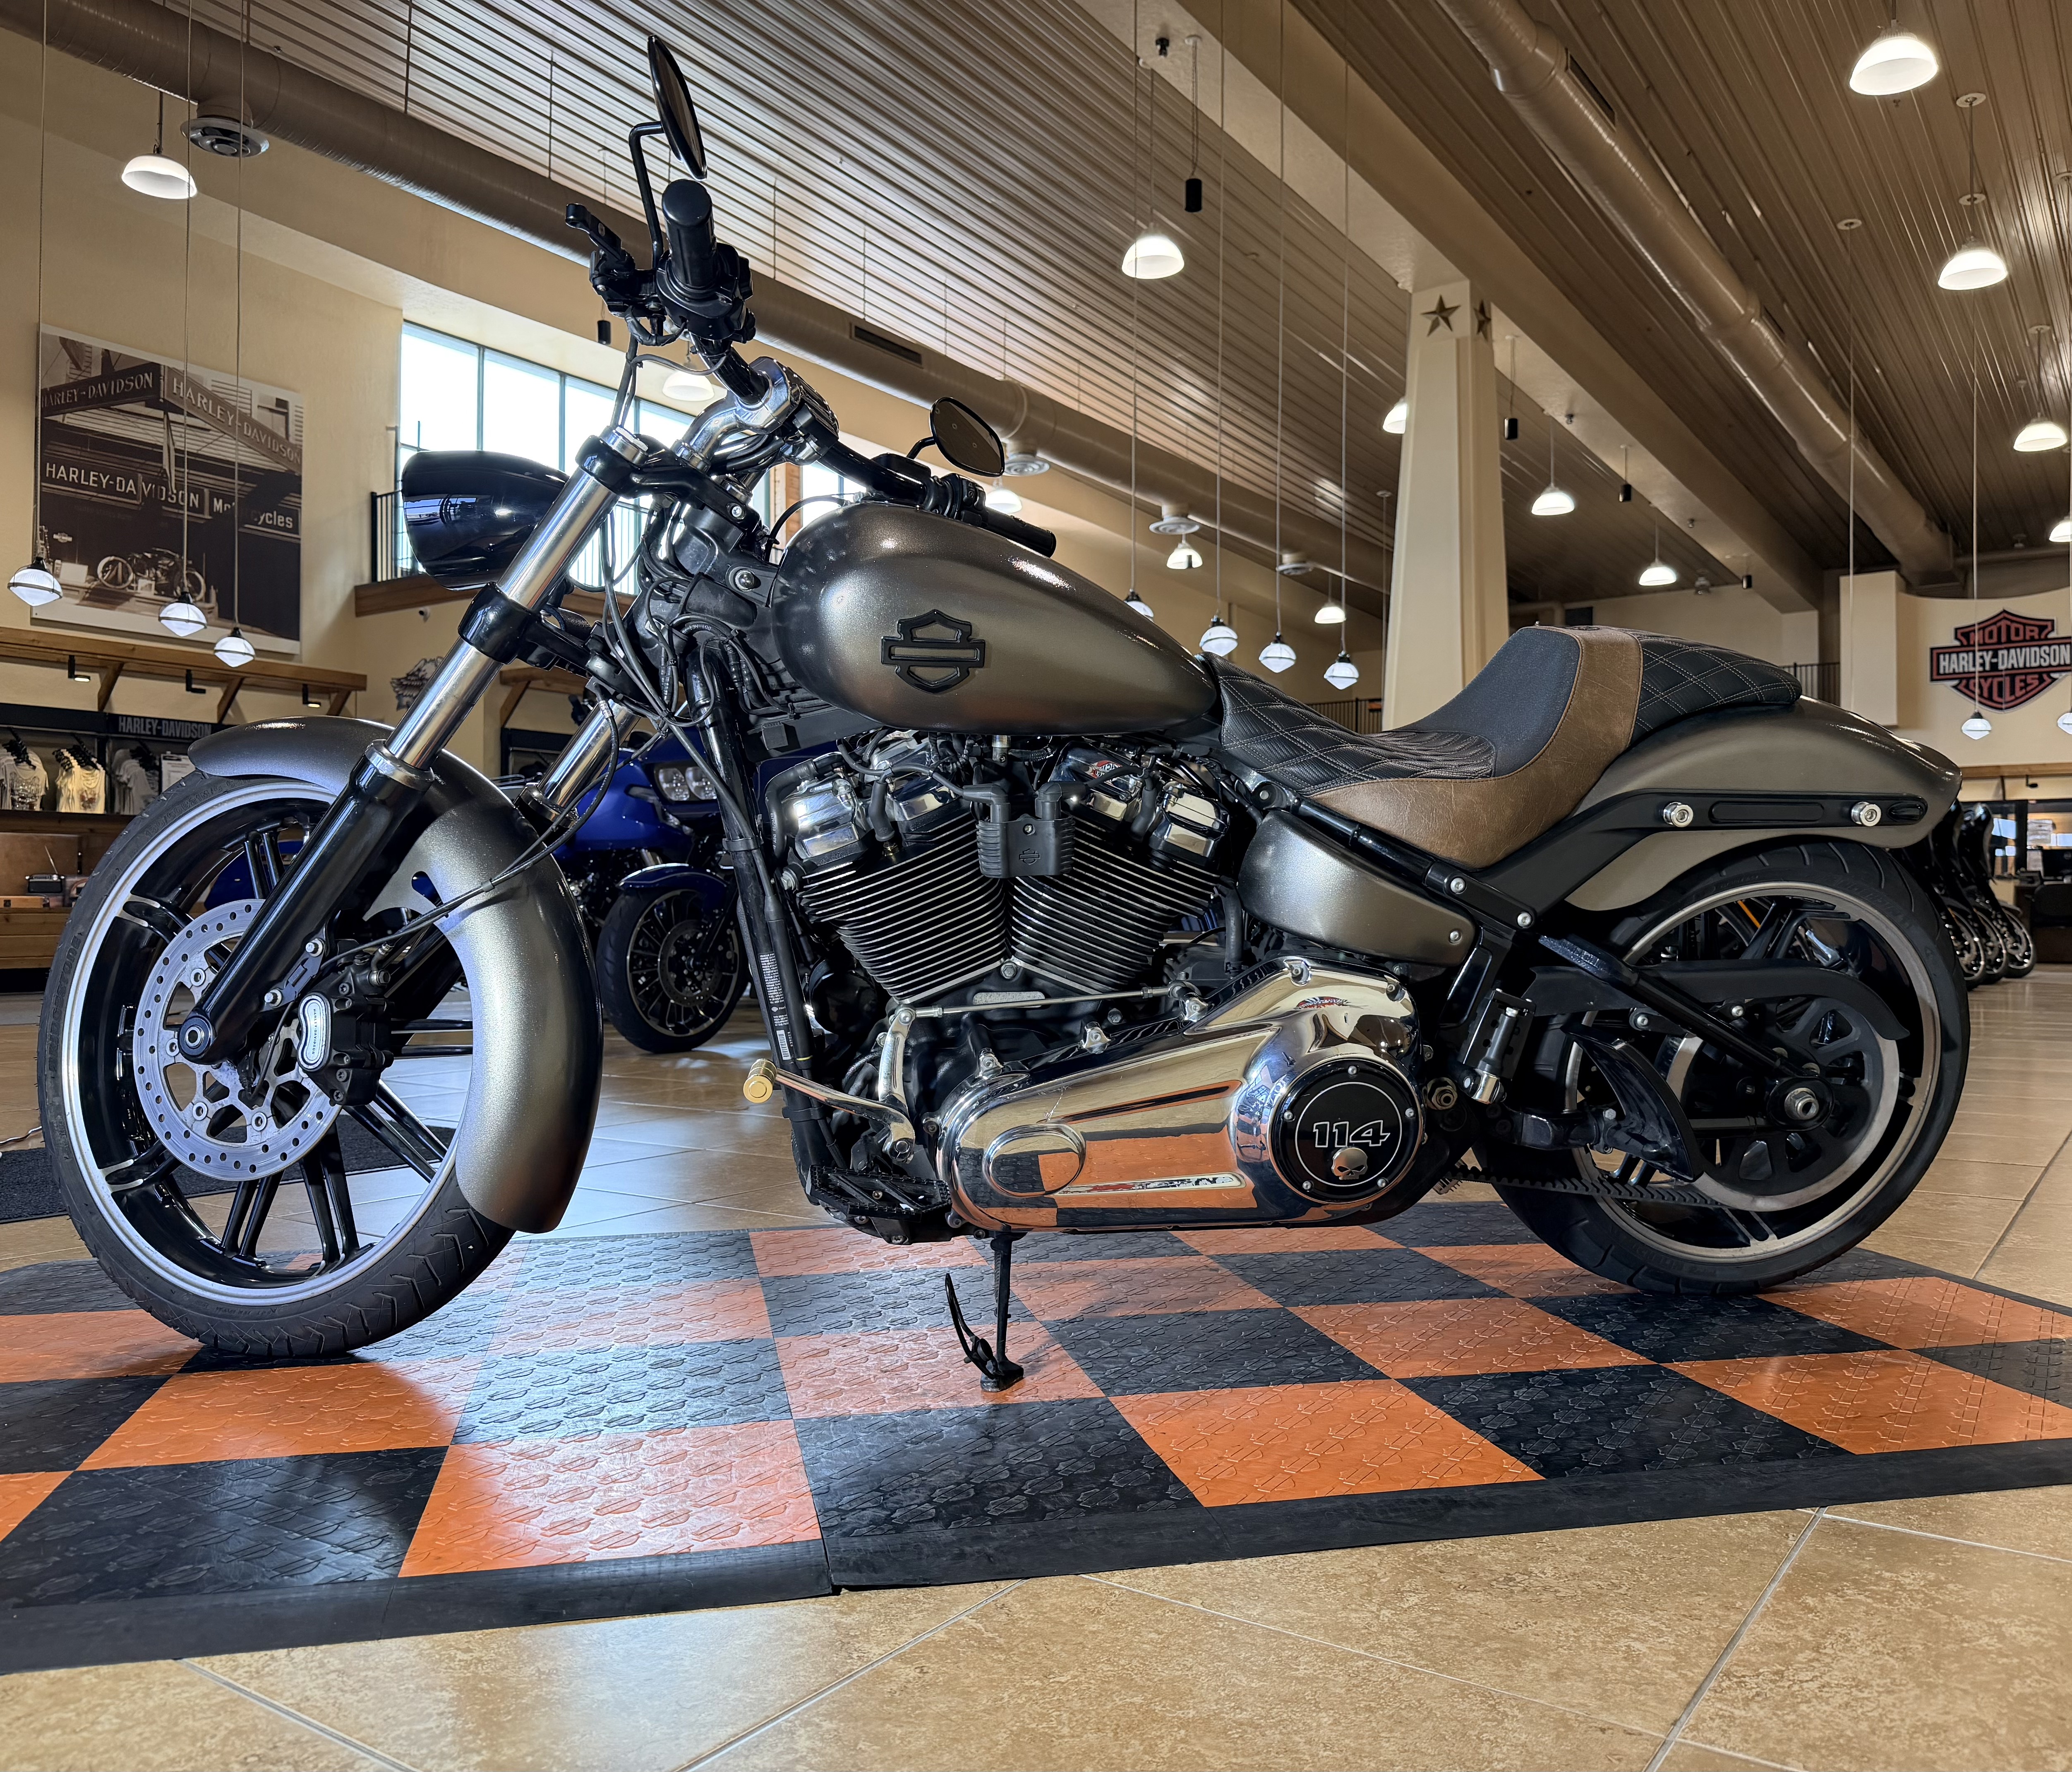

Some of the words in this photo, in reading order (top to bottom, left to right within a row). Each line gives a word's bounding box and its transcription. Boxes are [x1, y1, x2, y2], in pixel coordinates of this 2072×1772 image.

[41, 372, 153, 408] HARLEY-DAVIDSON
[173, 377, 301, 464] HARLEY-DAVIDSON
[46, 462, 199, 508] HARLEY-DAVIDSON
[1969, 619, 2039, 645] MOTOR
[1939, 644, 2070, 674] HARLEY-DAVIDSON
[1969, 674, 2039, 703] CYCLES
[118, 716, 212, 739] HARLEY-DAVIDSON
[48, 935, 82, 1072] BRIDGESTONE
[1312, 1119, 1391, 1148] 114
